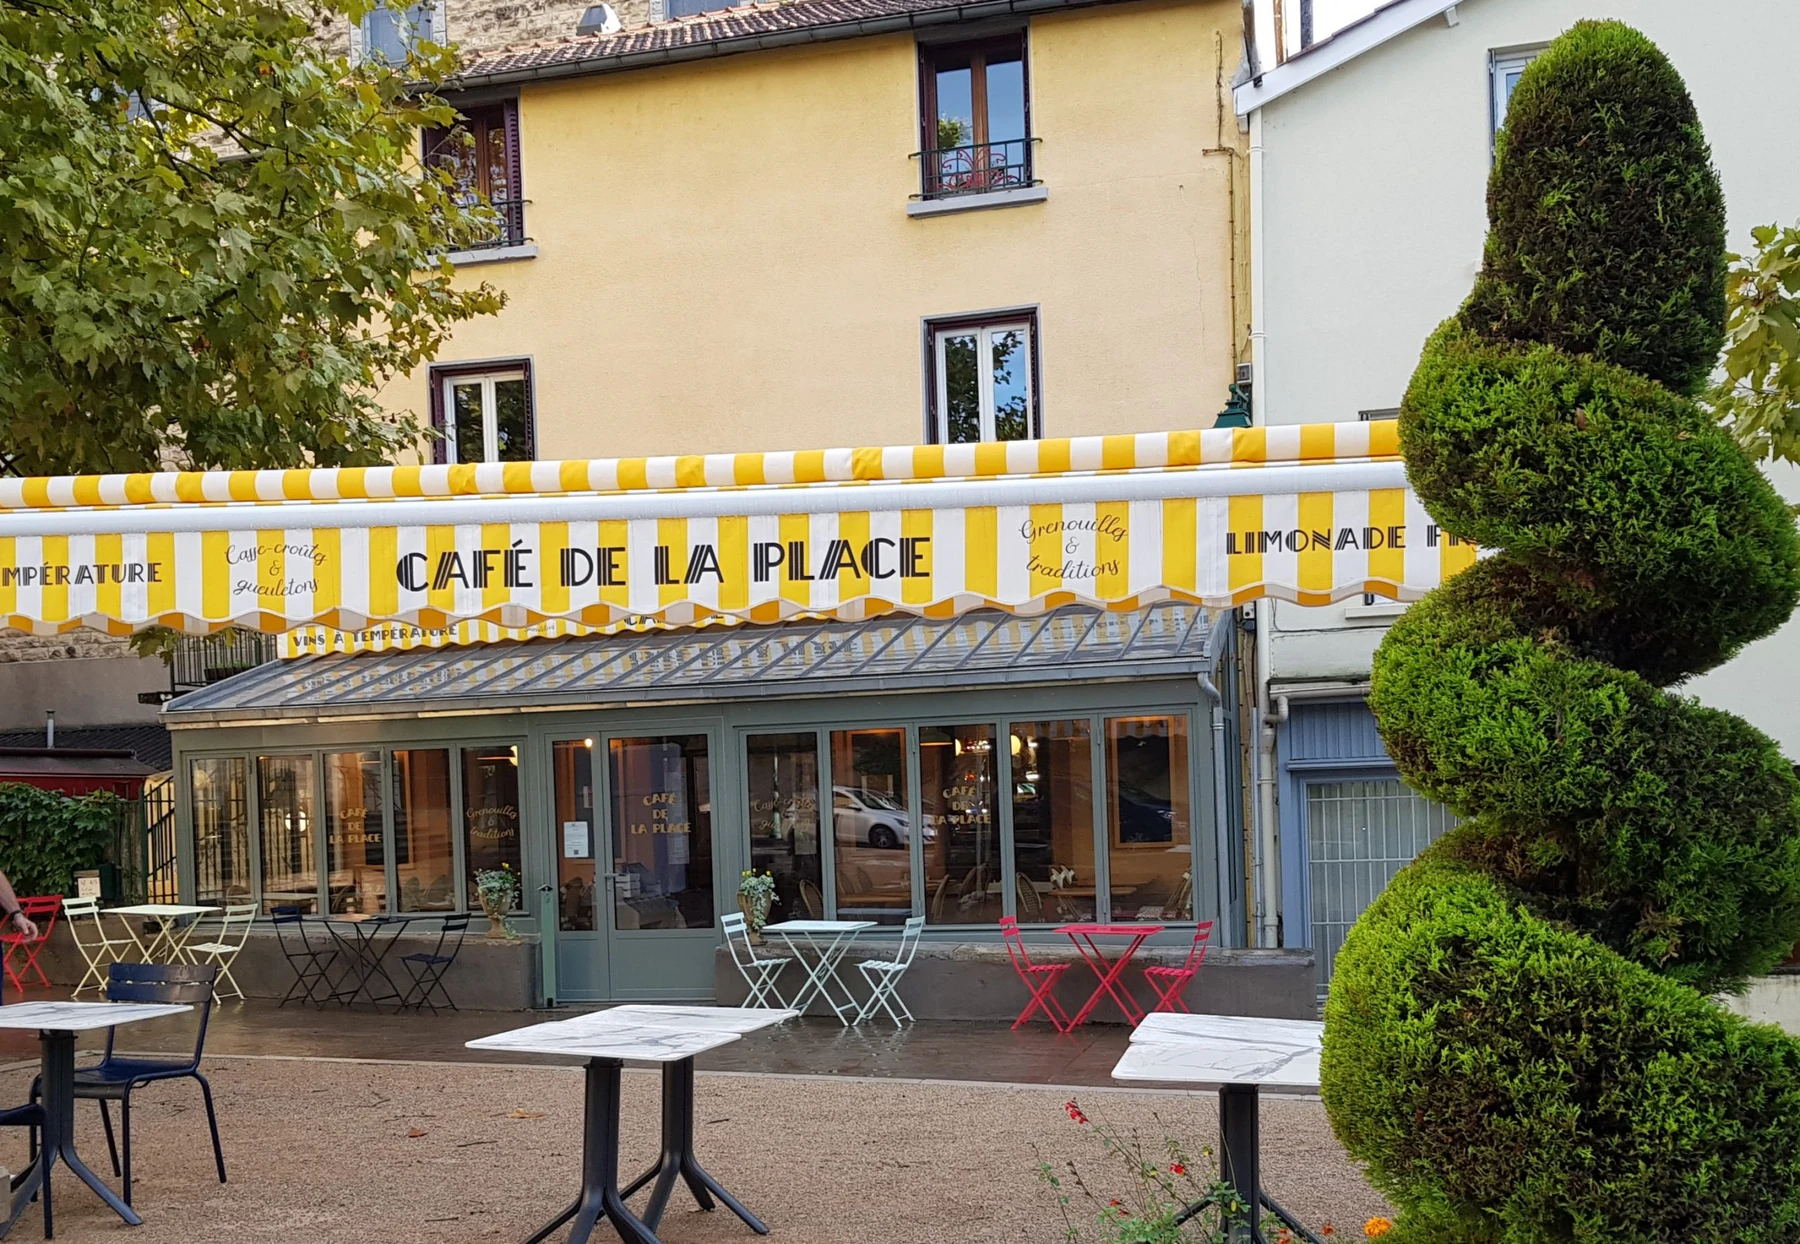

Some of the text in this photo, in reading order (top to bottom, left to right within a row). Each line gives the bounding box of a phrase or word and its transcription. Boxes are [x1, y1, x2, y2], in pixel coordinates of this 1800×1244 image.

[1065, 536, 1080, 554] &
[1226, 525, 1406, 555] LIMONADE
[269, 560, 281, 576] &
[396, 537, 931, 592] CAFÉ DE LA PLACE
[1026, 555, 1120, 579] traditions
[2, 561, 162, 587] MPÉRATURE
[233, 578, 319, 596] gueuletons
[293, 634, 326, 647] VINS
[334, 631, 344, 644] À
[952, 801, 968, 811] DE
[652, 809, 668, 820] DE
[930, 814, 991, 825] LA PLACE
[347, 821, 362, 831] DE
[630, 822, 692, 835] LA PLACE
[329, 833, 382, 844] LA PLACE
